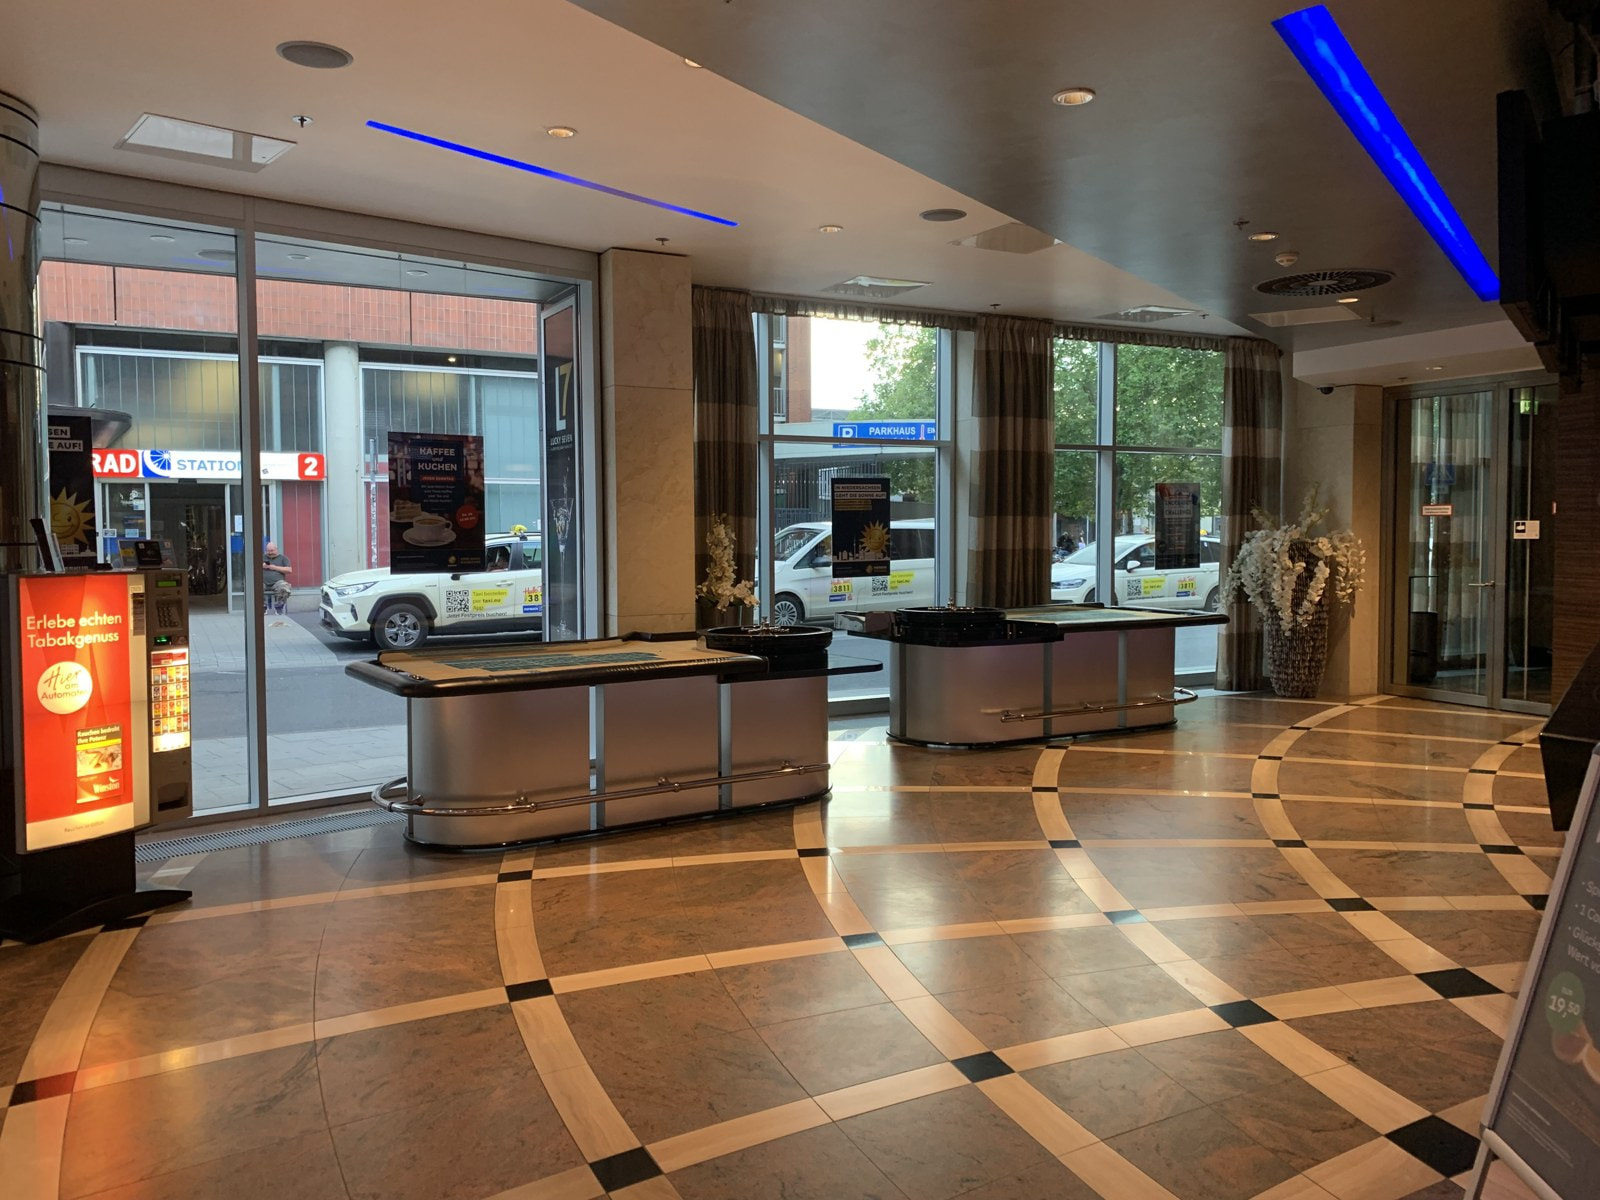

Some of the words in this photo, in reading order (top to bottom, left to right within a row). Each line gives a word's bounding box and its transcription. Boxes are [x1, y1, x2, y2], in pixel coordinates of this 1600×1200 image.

[869, 427, 916, 435] PARKHAUS
[56, 442, 82, 450] AUF!
[420, 447, 456, 456] KAFFEE
[304, 457, 318, 476] 2
[418, 462, 457, 471] KUCHEN
[26, 613, 76, 630] Erlebe
[78, 610, 122, 627] echten
[27, 630, 119, 649] Tabakgenuss
[43, 666, 82, 690] Hier
[92, 782, 120, 794] Winston
[1567, 943, 1590, 967] Wert
